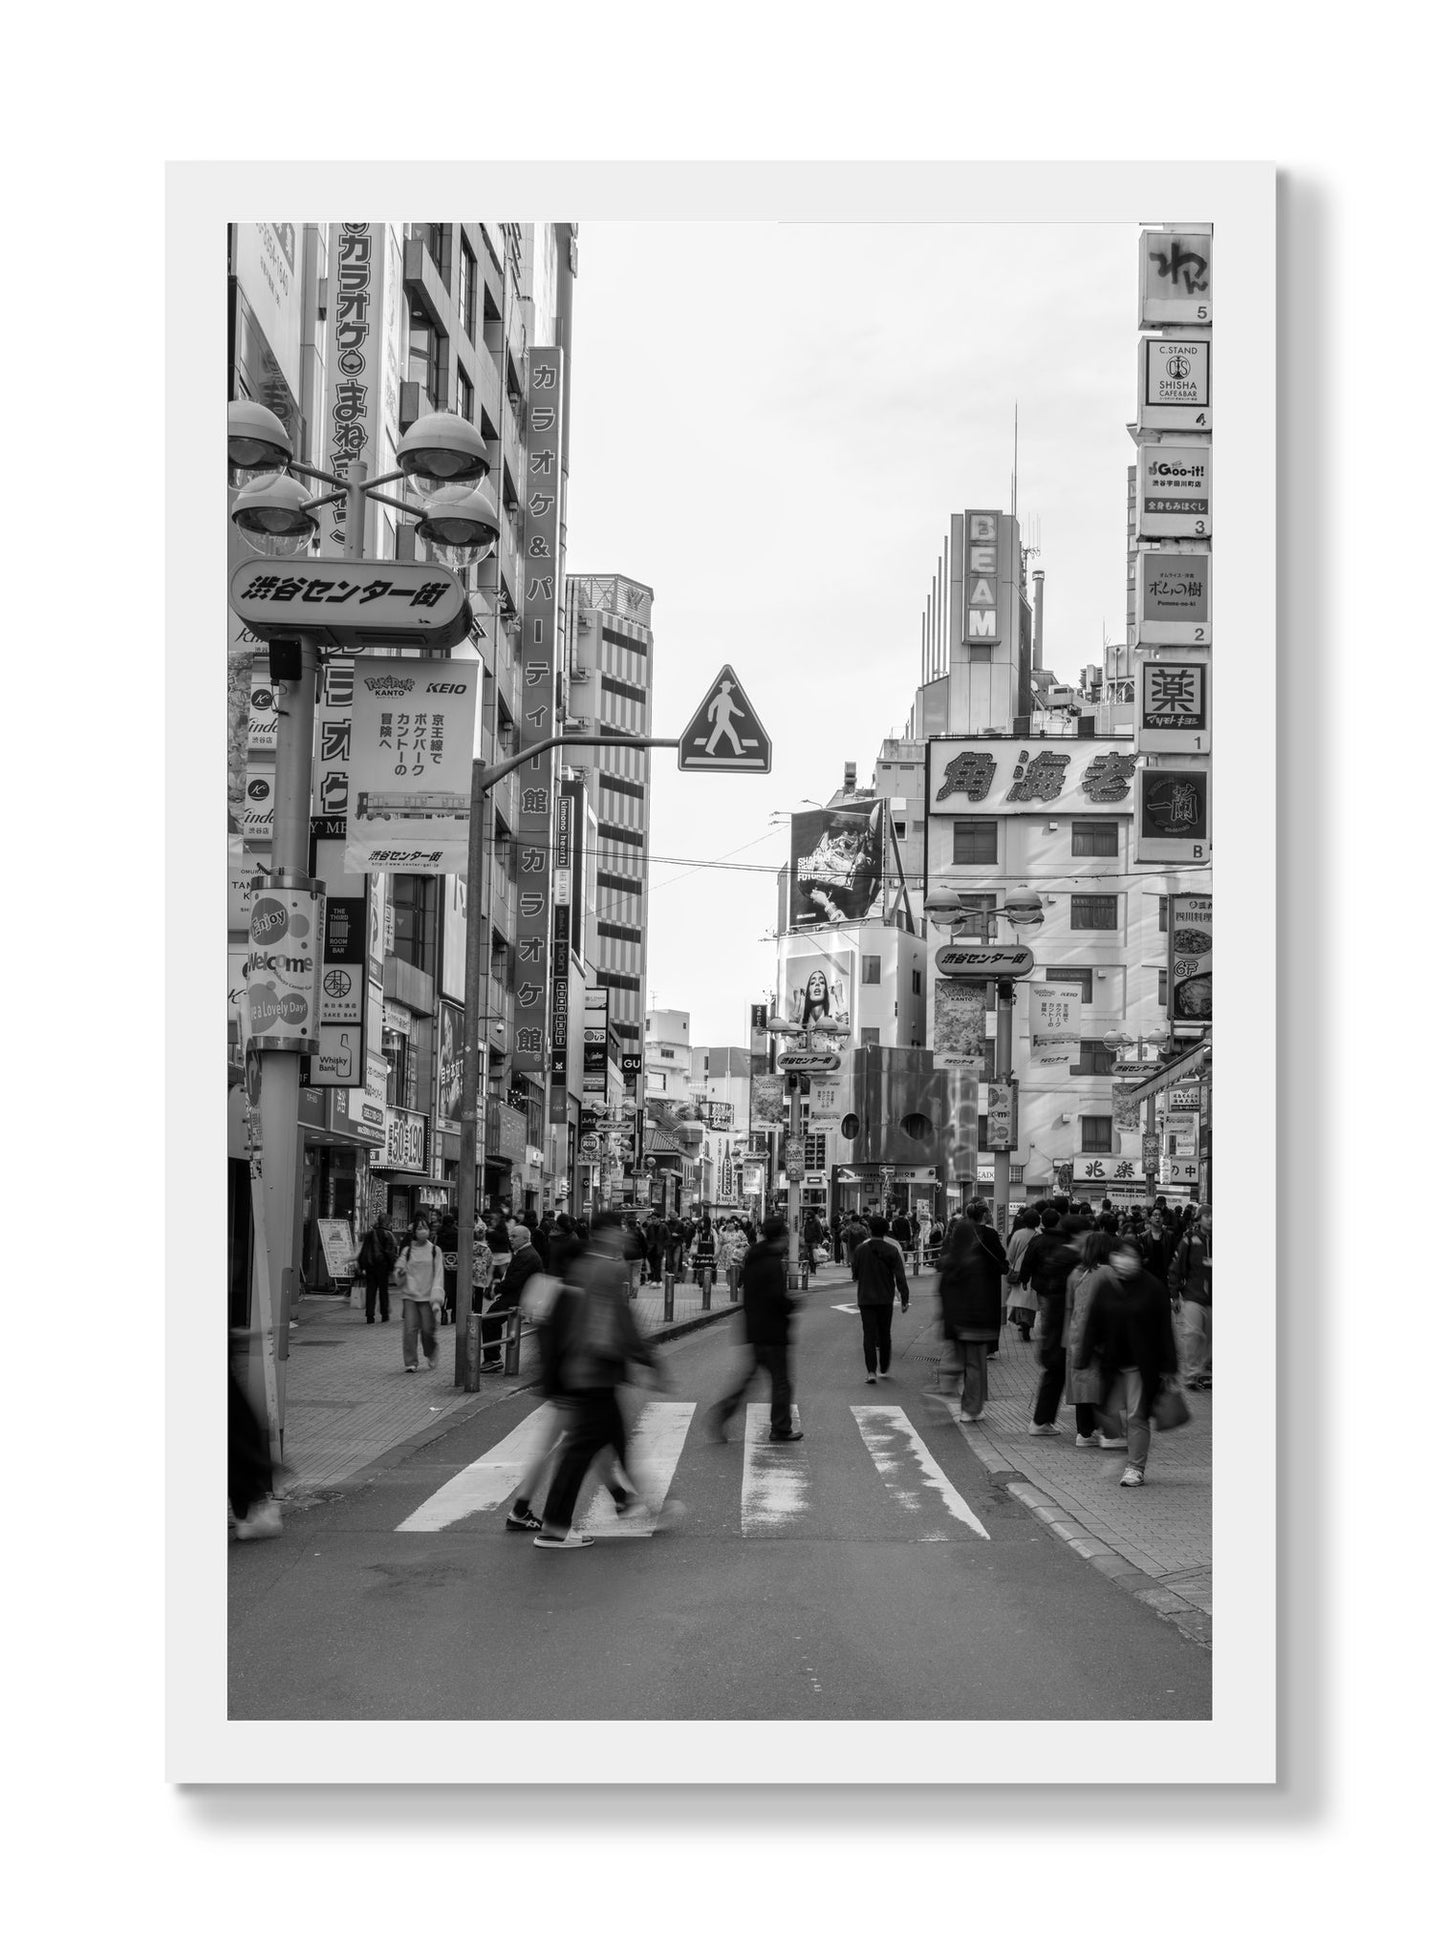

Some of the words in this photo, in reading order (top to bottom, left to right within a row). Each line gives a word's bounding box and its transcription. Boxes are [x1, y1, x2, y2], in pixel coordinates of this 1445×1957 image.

[1197, 306, 1208, 319] 5
[1159, 346, 1198, 355] C.STAND
[1159, 380, 1198, 389] SHISHA
[1196, 413, 1206, 426] 4
[1158, 463, 1205, 477] Goo-it!
[1194, 520, 1205, 534] 3
[969, 514, 998, 637] BEAM
[241, 575, 452, 607] 渋谷センター街
[1195, 628, 1205, 641] 2
[375, 689, 405, 697] KANTO
[426, 682, 467, 695] KEIO
[1152, 669, 1194, 712] 薬
[379, 713, 394, 749] 冒険へ
[395, 713, 411, 776] カントーの
[431, 714, 445, 765] 京王線で
[1194, 736, 1201, 749] 1
[560, 801, 569, 831] kimono
[369, 850, 444, 862] 渋谷センター街
[559, 834, 568, 864] hearts
[1193, 844, 1203, 858] B
[251, 910, 288, 938] Enjoy
[515, 848, 546, 1052] カラオケ館
[248, 952, 313, 973] Welcome
[942, 953, 1029, 965] 渋谷センター街
[1175, 960, 1199, 977] 6F
[263, 1001, 288, 1017] Lovely
[289, 1002, 307, 1013] Day!
[320, 1056, 348, 1066] Whisky
[623, 1059, 641, 1069] GU
